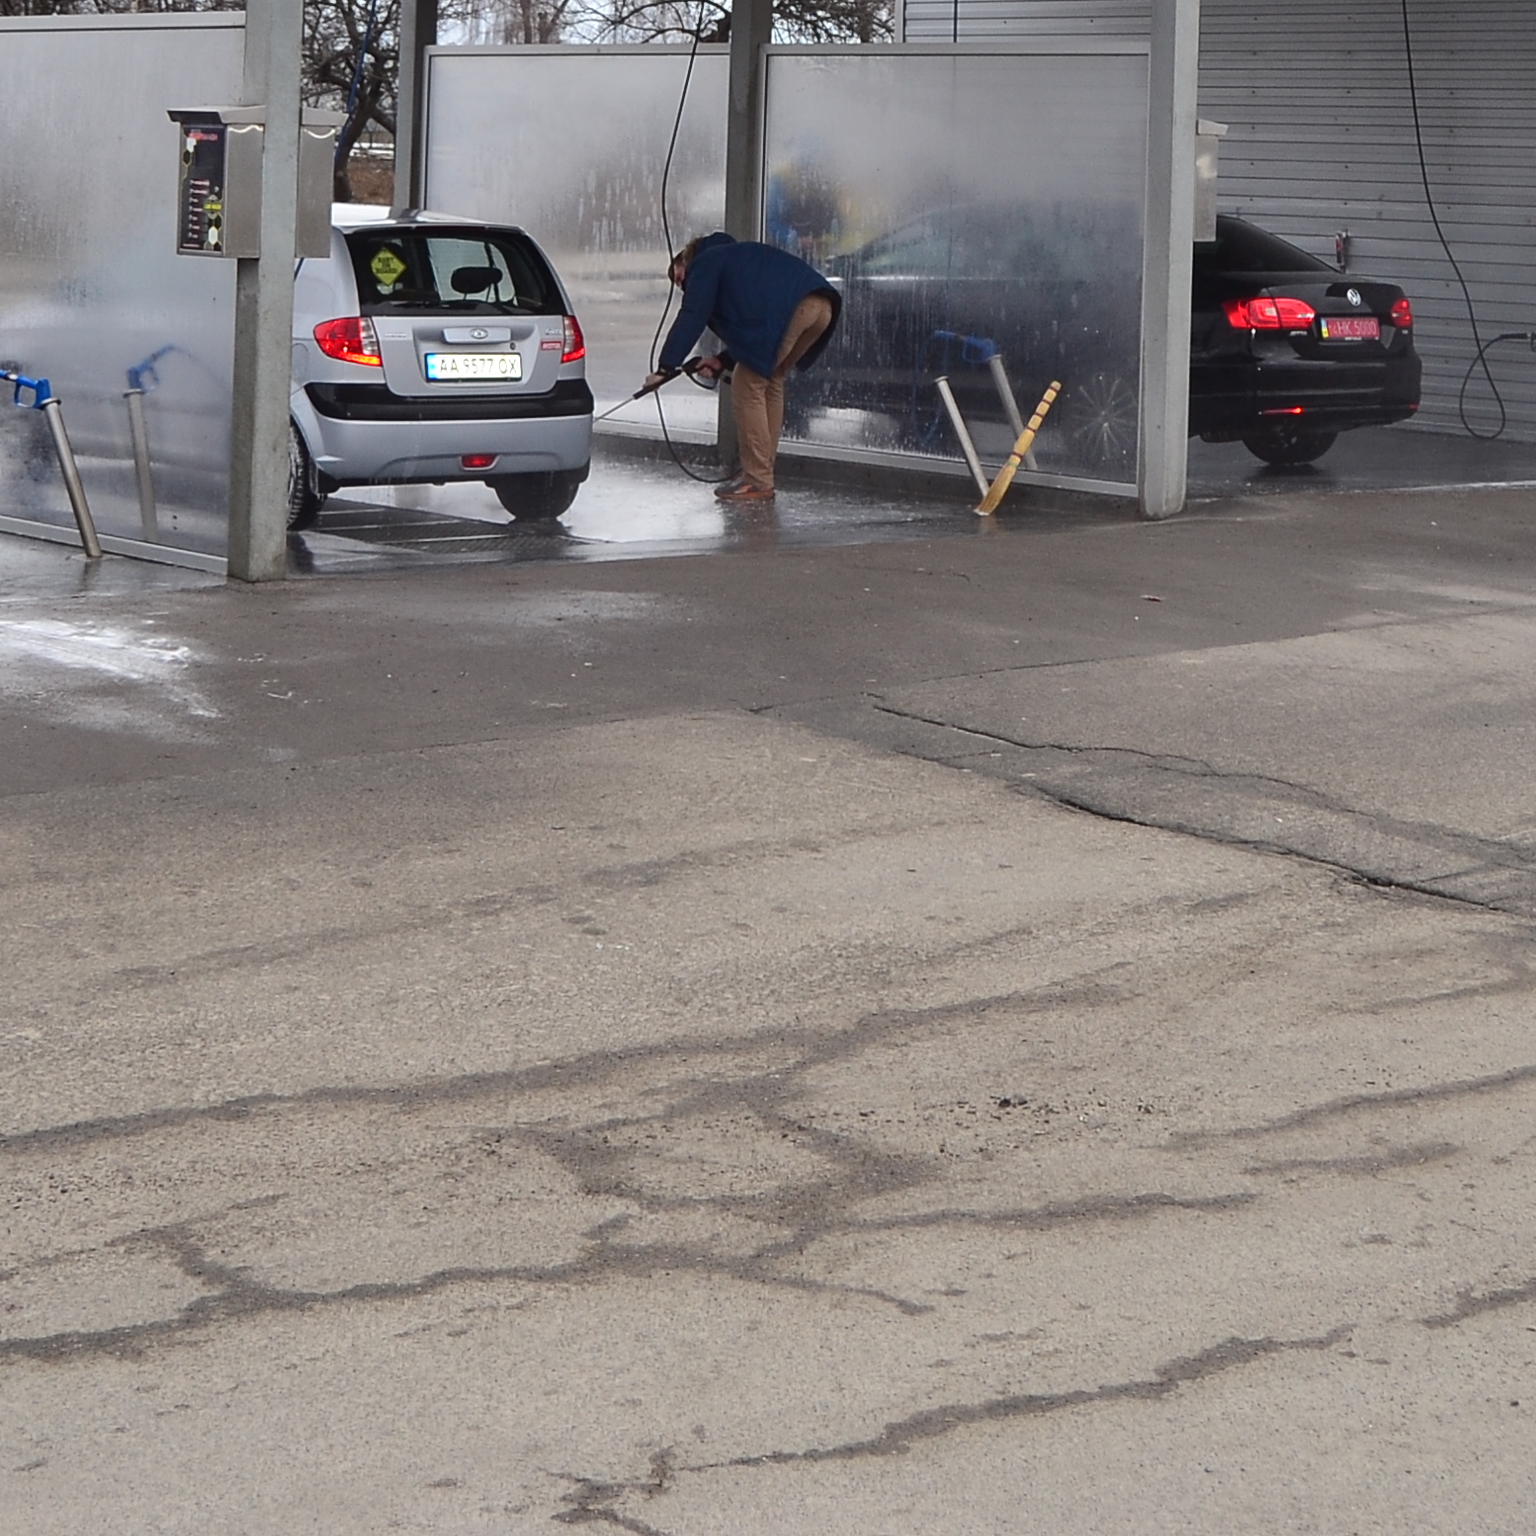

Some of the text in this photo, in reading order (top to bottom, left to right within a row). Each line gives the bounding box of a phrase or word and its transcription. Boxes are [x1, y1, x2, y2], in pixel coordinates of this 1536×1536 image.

[439, 358, 517, 375] AA 9577 OX
